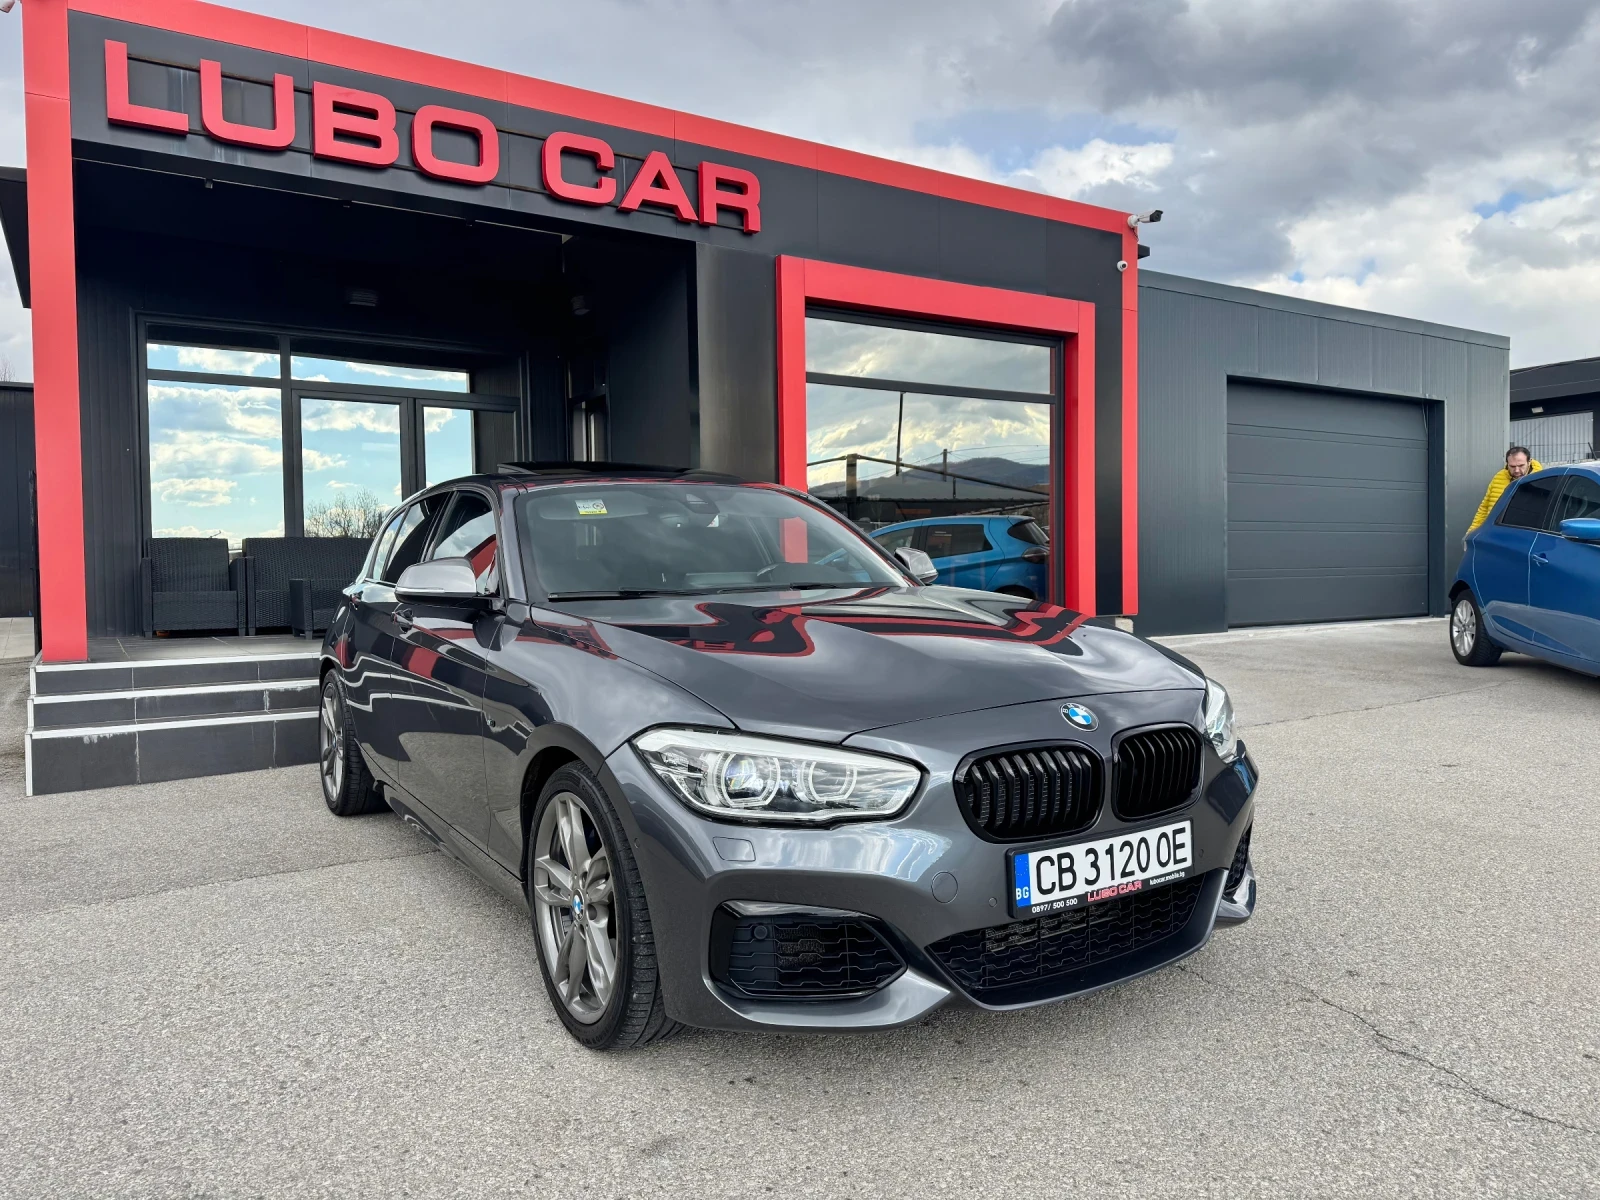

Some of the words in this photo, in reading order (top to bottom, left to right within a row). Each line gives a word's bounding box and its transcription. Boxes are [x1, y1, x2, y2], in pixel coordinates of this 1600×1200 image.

[104, 39, 499, 186] LUBO
[541, 130, 761, 235] CAR
[1035, 851, 1077, 896] CB
[1084, 836, 1151, 886] 3120
[1156, 826, 1188, 868] OE
[1149, 871, 1186, 886] lubocar.mobile.bg
[1016, 886, 1030, 901] BG
[1087, 886, 1118, 902] LUBO
[1118, 879, 1143, 895] CAR
[1031, 903, 1052, 914] 0897/
[1052, 900, 1065, 910] 500
[1066, 897, 1078, 907] 500
